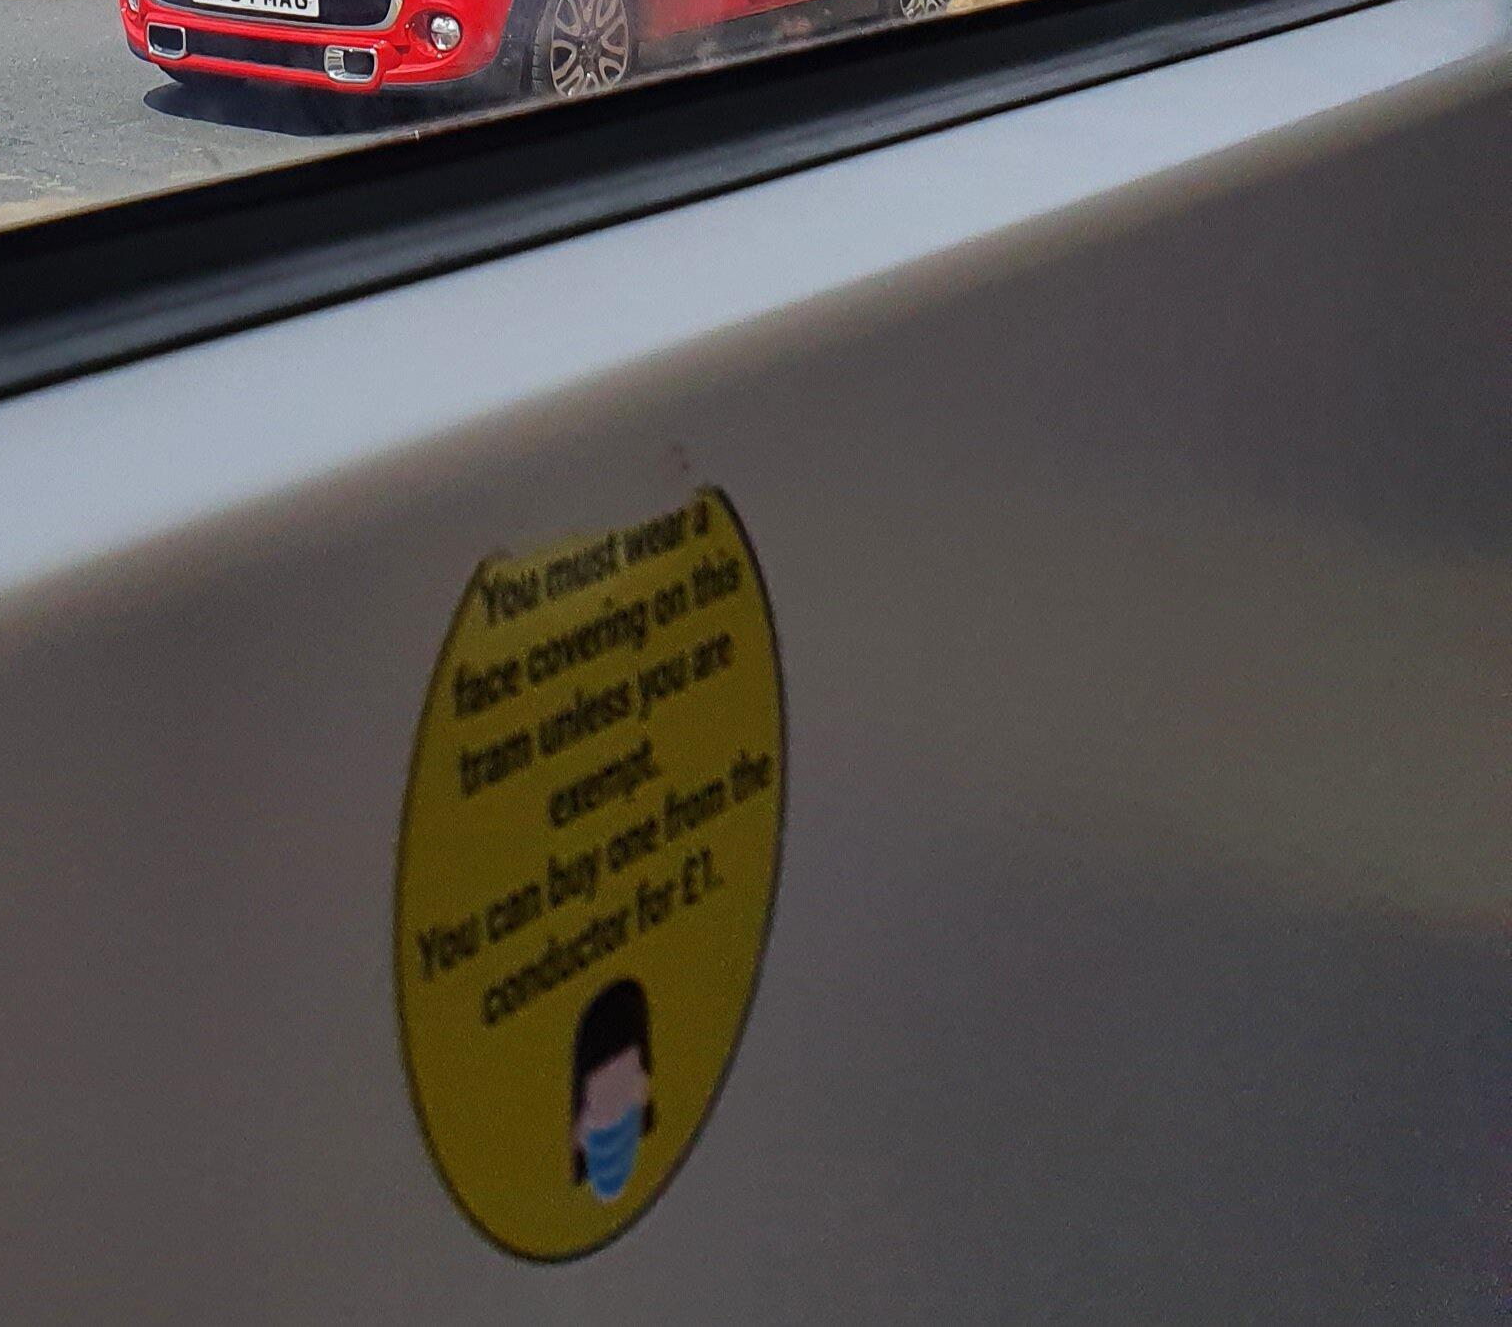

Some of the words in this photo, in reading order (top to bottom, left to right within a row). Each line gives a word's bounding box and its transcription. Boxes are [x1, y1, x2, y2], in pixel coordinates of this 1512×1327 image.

[453, 658, 522, 718] face
[527, 597, 648, 687] covering
[654, 582, 687, 627] on
[692, 554, 741, 610] this
[483, 567, 540, 627] You
[545, 531, 620, 599] must
[624, 507, 687, 566] wear
[690, 500, 710, 537] a
[539, 682, 633, 755] unless
[636, 659, 687, 722] you
[692, 632, 734, 682] are
[549, 738, 661, 829] exempt.
[418, 915, 480, 981] You
[487, 884, 543, 945] can
[548, 849, 601, 910] buy
[606, 818, 658, 872] one
[663, 780, 726, 843] from
[732, 747, 775, 804] the
[483, 907, 630, 1026] conductor
[635, 876, 677, 935] for
[682, 847, 724, 907] £1.
